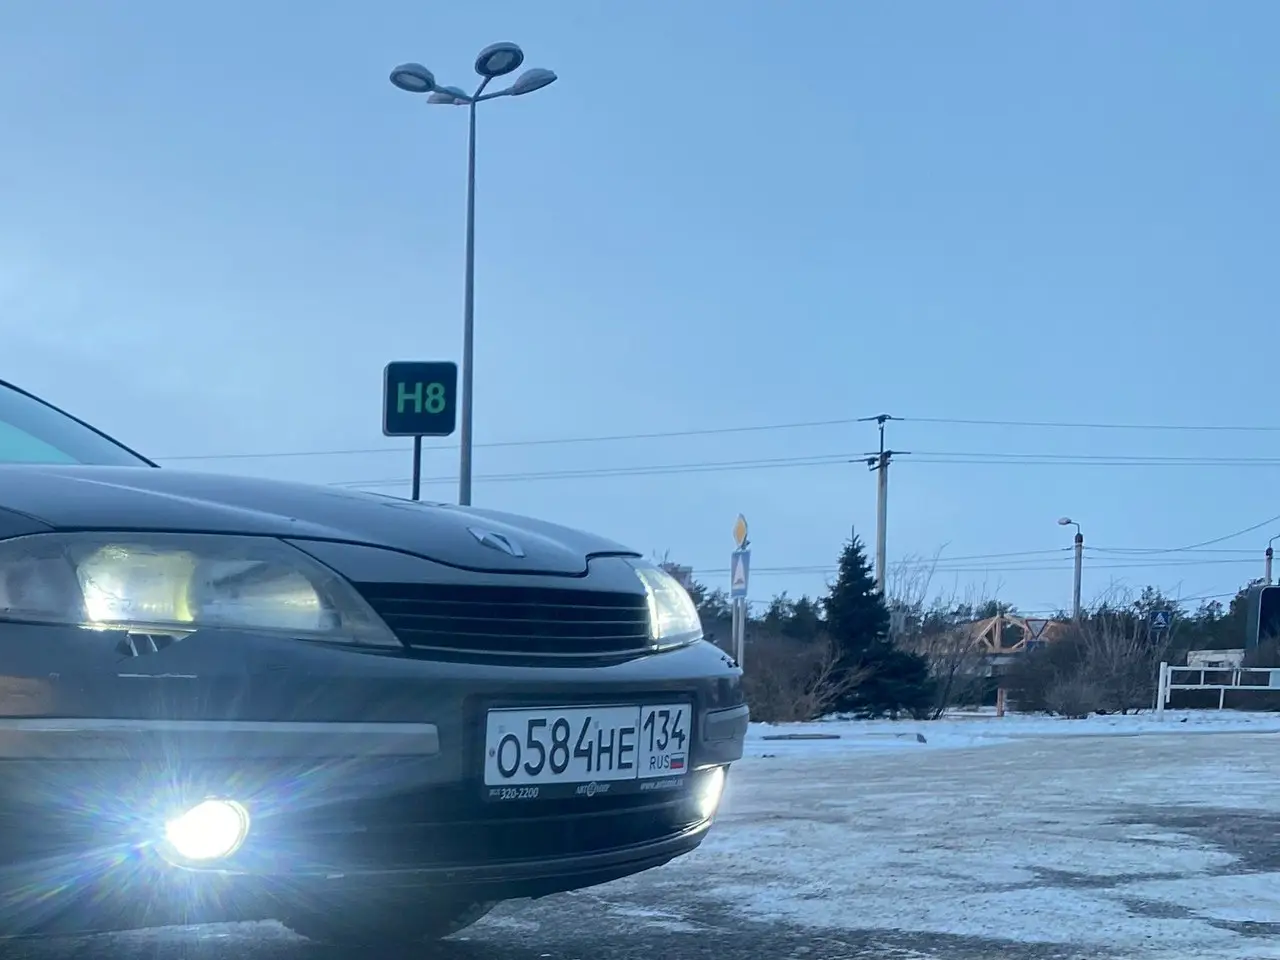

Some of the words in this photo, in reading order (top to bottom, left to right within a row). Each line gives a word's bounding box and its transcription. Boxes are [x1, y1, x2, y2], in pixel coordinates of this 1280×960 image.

[397, 382, 446, 414] H8
[643, 709, 686, 752] 134
[649, 755, 670, 771] RUS
[500, 787, 540, 800] 320-2200
